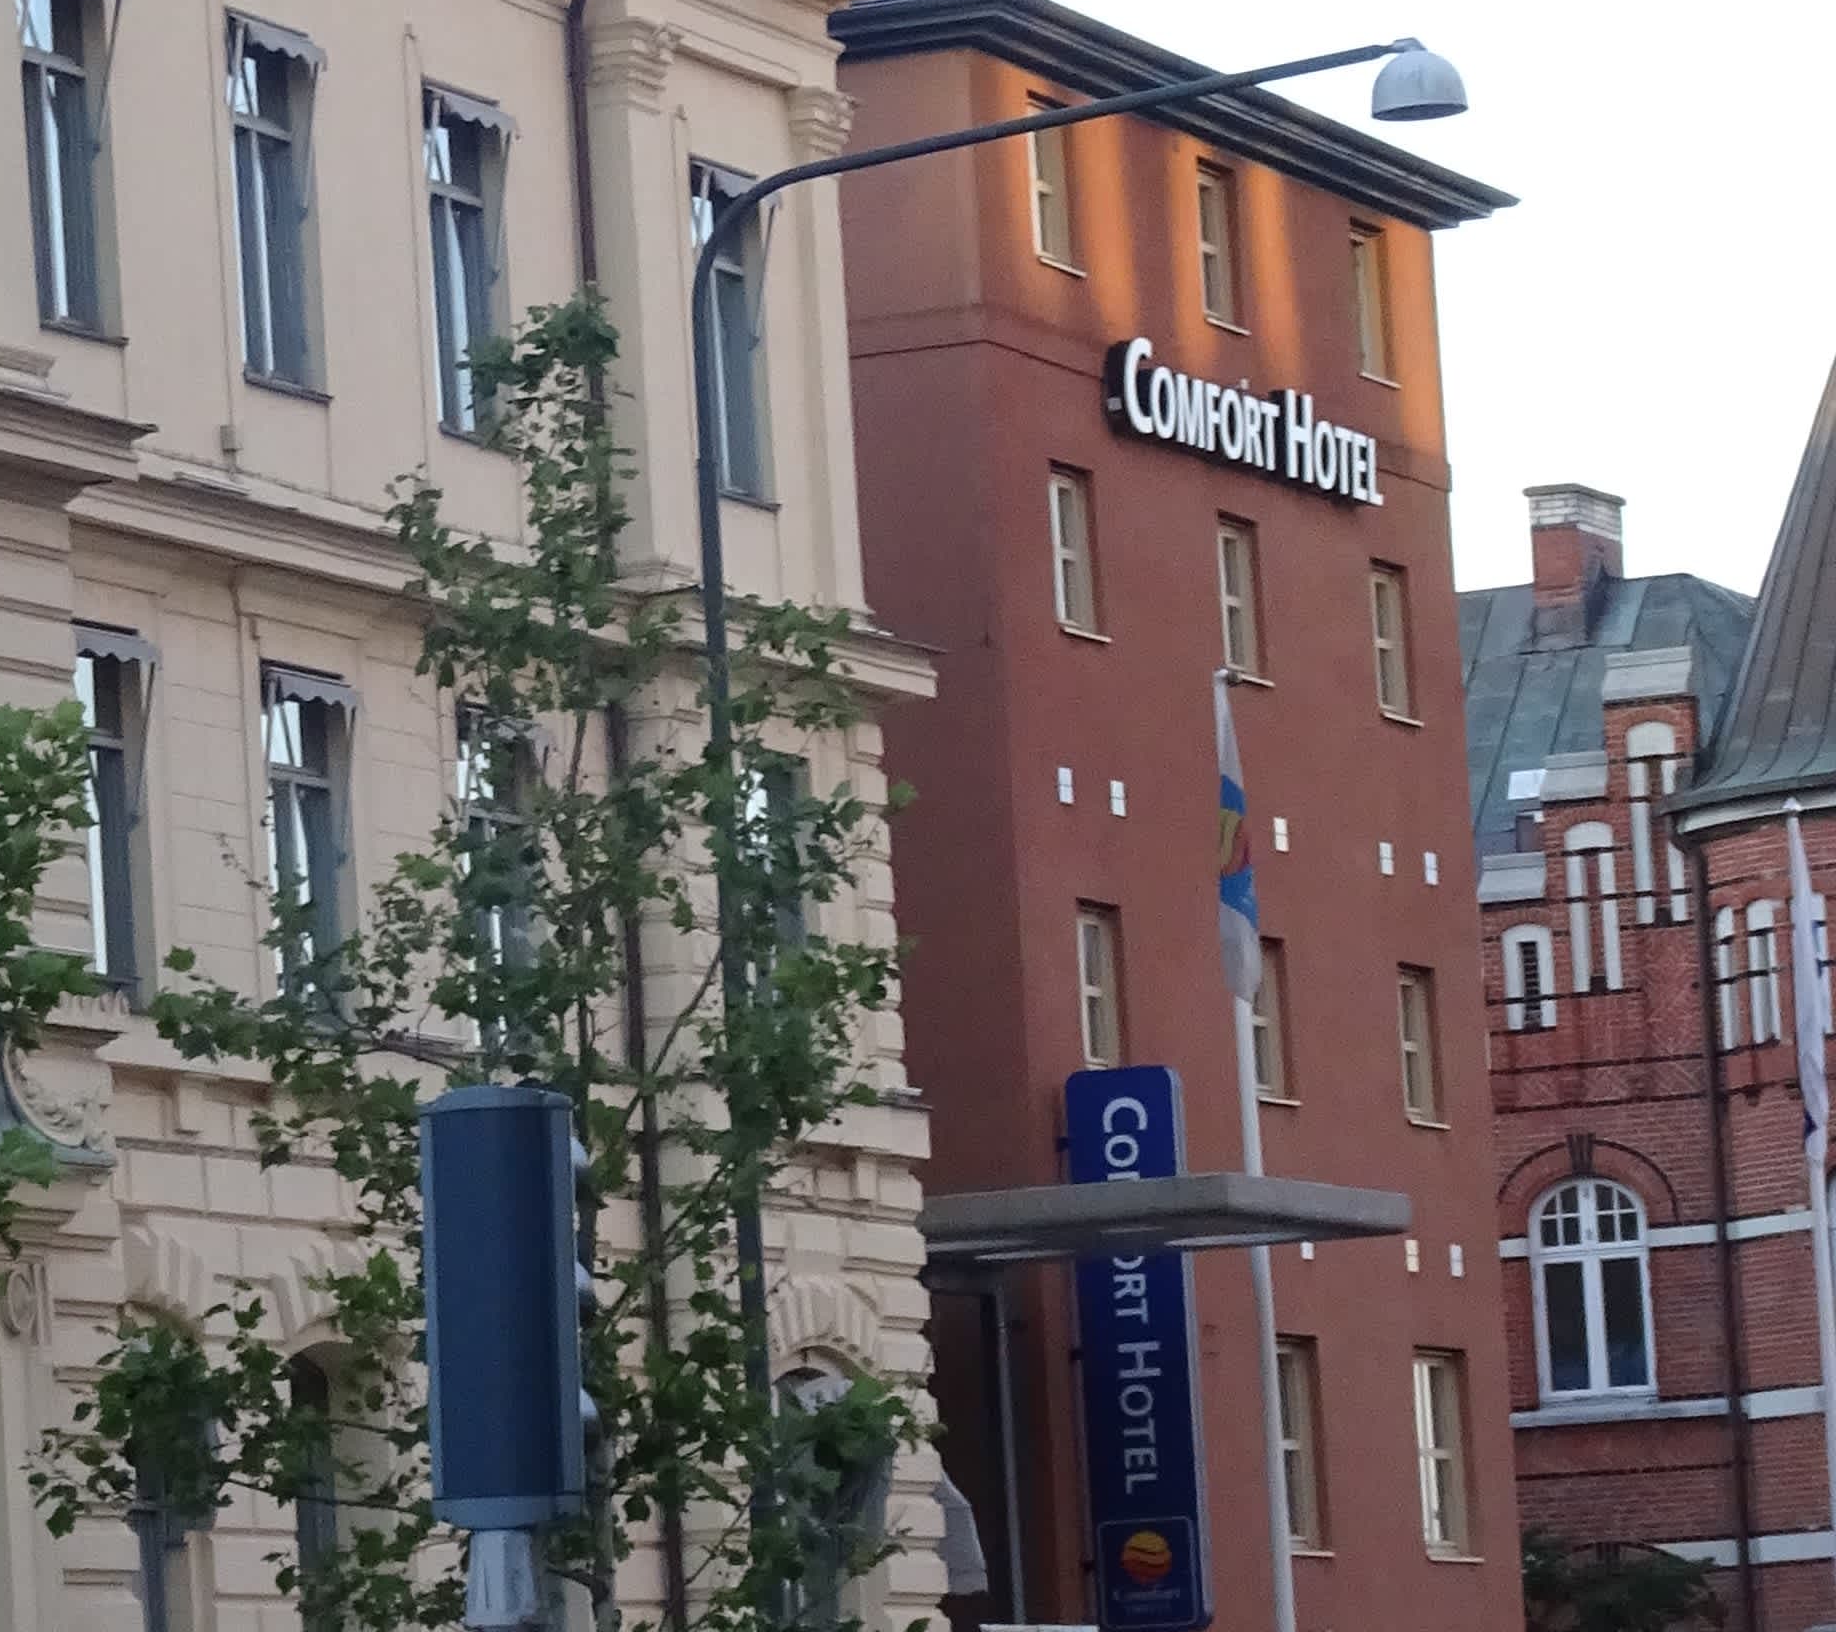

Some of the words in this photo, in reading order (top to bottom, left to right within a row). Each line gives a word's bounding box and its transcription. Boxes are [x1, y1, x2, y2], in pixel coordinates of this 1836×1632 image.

[1124, 337, 1280, 471] COMFORT
[1285, 389, 1384, 506] HOTEL
[1102, 1096, 1149, 1325] CORT
[1117, 1340, 1162, 1495] HOTEL
